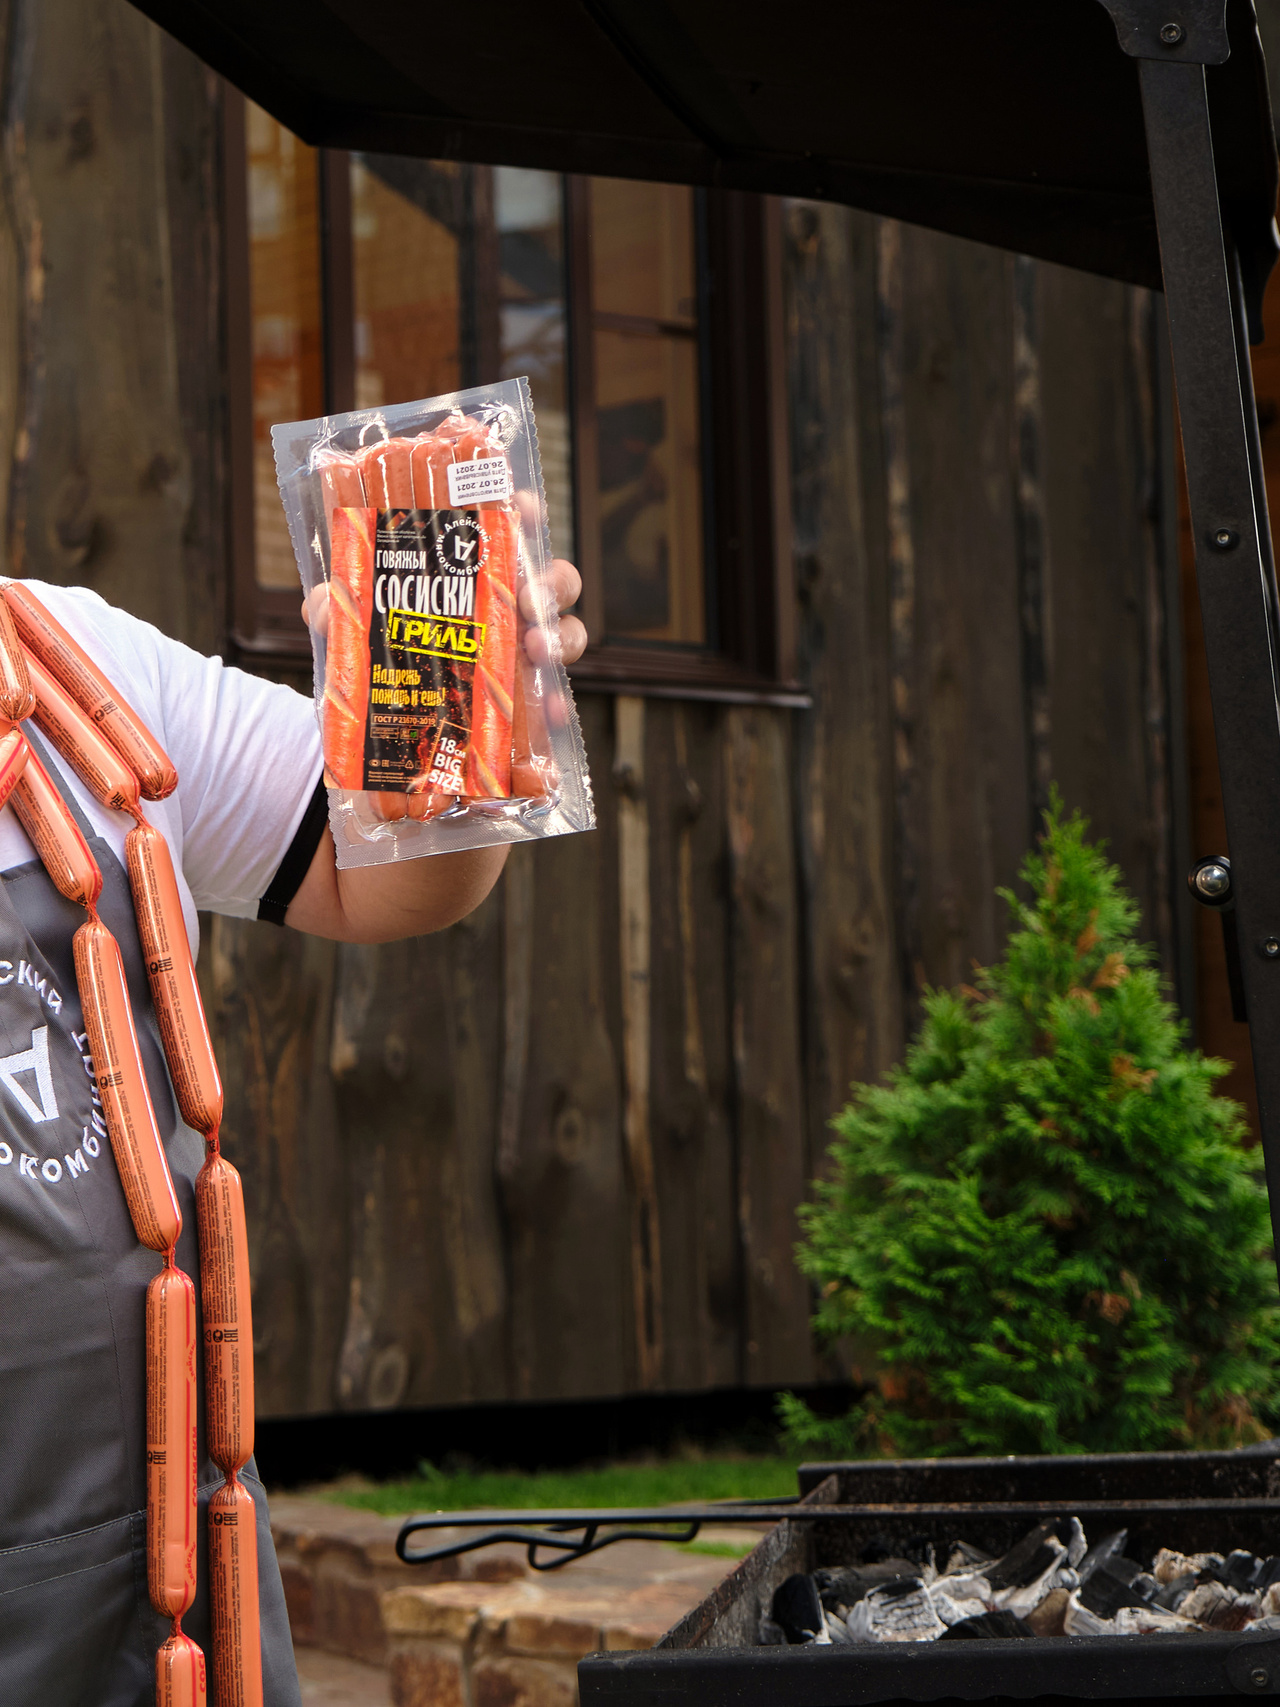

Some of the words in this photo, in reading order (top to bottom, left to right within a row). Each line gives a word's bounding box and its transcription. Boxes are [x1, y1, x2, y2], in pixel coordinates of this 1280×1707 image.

[456, 461, 503, 474] 26.07.2021
[458, 479, 504, 491] 26.07.2021
[444, 516, 492, 543] Алейский
[376, 550, 426, 570] ГОВЯЖЬИ
[375, 574, 474, 616] СОСИСКИ
[391, 616, 478, 653] ГРИЛЬ
[372, 664, 420, 688] Надрежь
[411, 690, 418, 706] и
[421, 687, 446, 706] ешь!
[434, 753, 462, 773] BIG
[428, 769, 463, 791] SIZE
